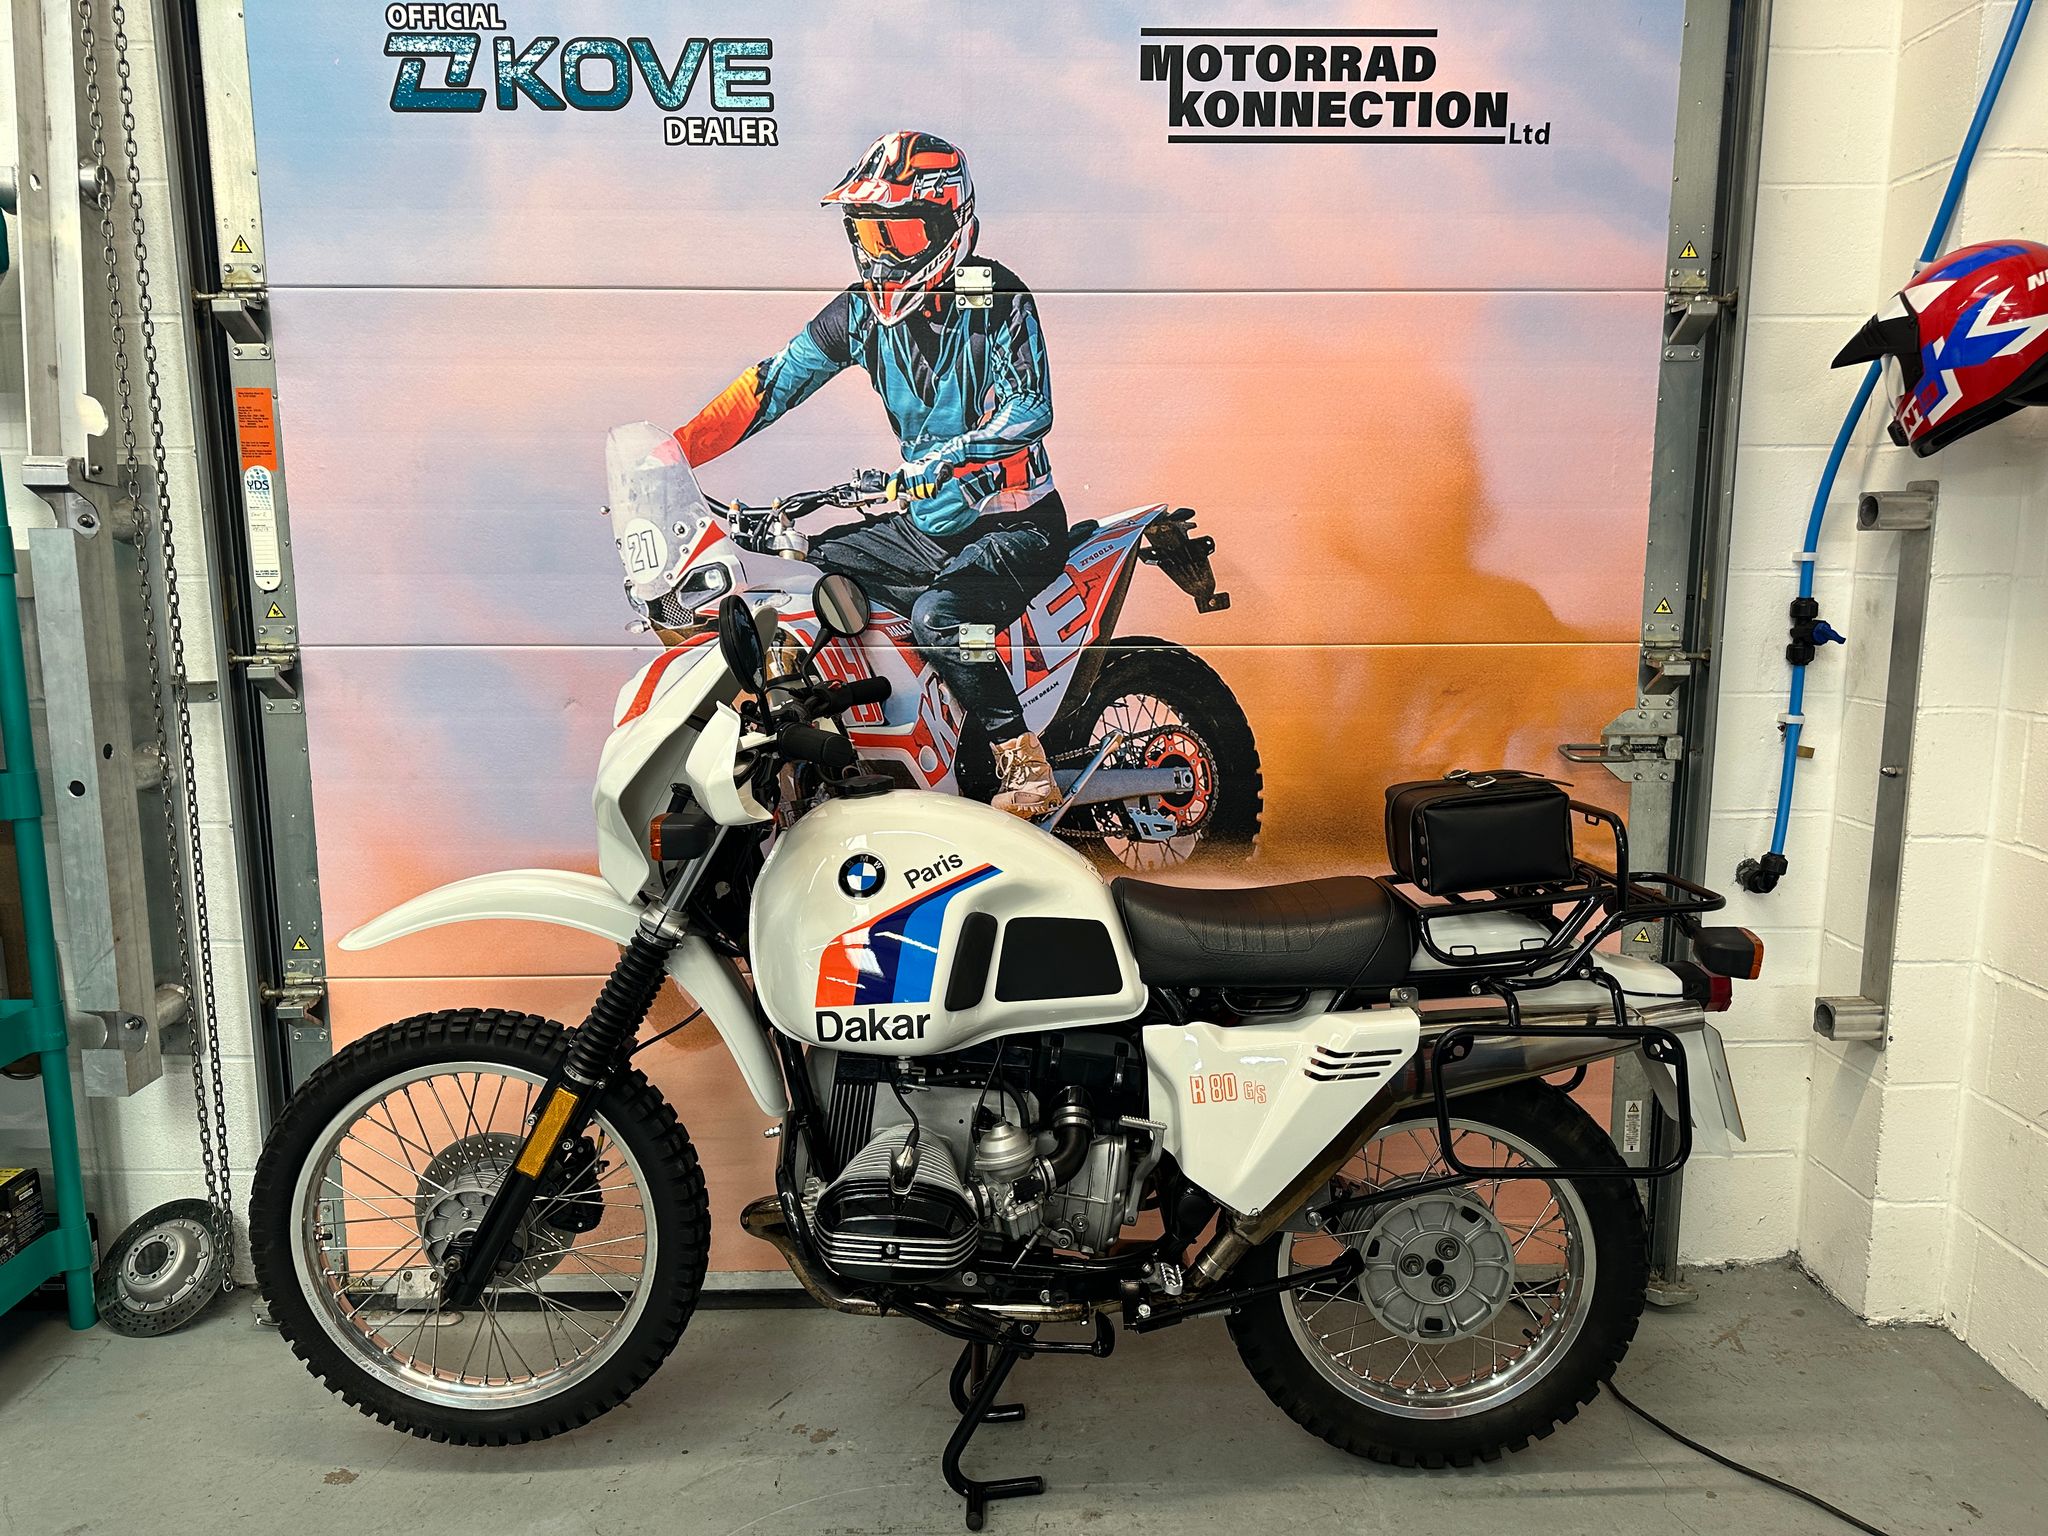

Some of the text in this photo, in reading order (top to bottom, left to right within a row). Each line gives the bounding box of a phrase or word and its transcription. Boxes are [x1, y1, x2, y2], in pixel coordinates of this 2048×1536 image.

[386, 3, 505, 30] OFFICIAL
[494, 37, 774, 111] KOVE
[1140, 44, 1437, 82] MOTORRAD
[665, 117, 779, 146] DEALER
[1168, 90, 1551, 145] KONNECTION Ltd
[246, 480, 270, 491] YDS
[627, 529, 659, 573] 21
[904, 853, 964, 889] Paris
[815, 1008, 930, 1043] Dakar
[1190, 1075, 1205, 1104] R
[1209, 1072, 1238, 1102] 80
